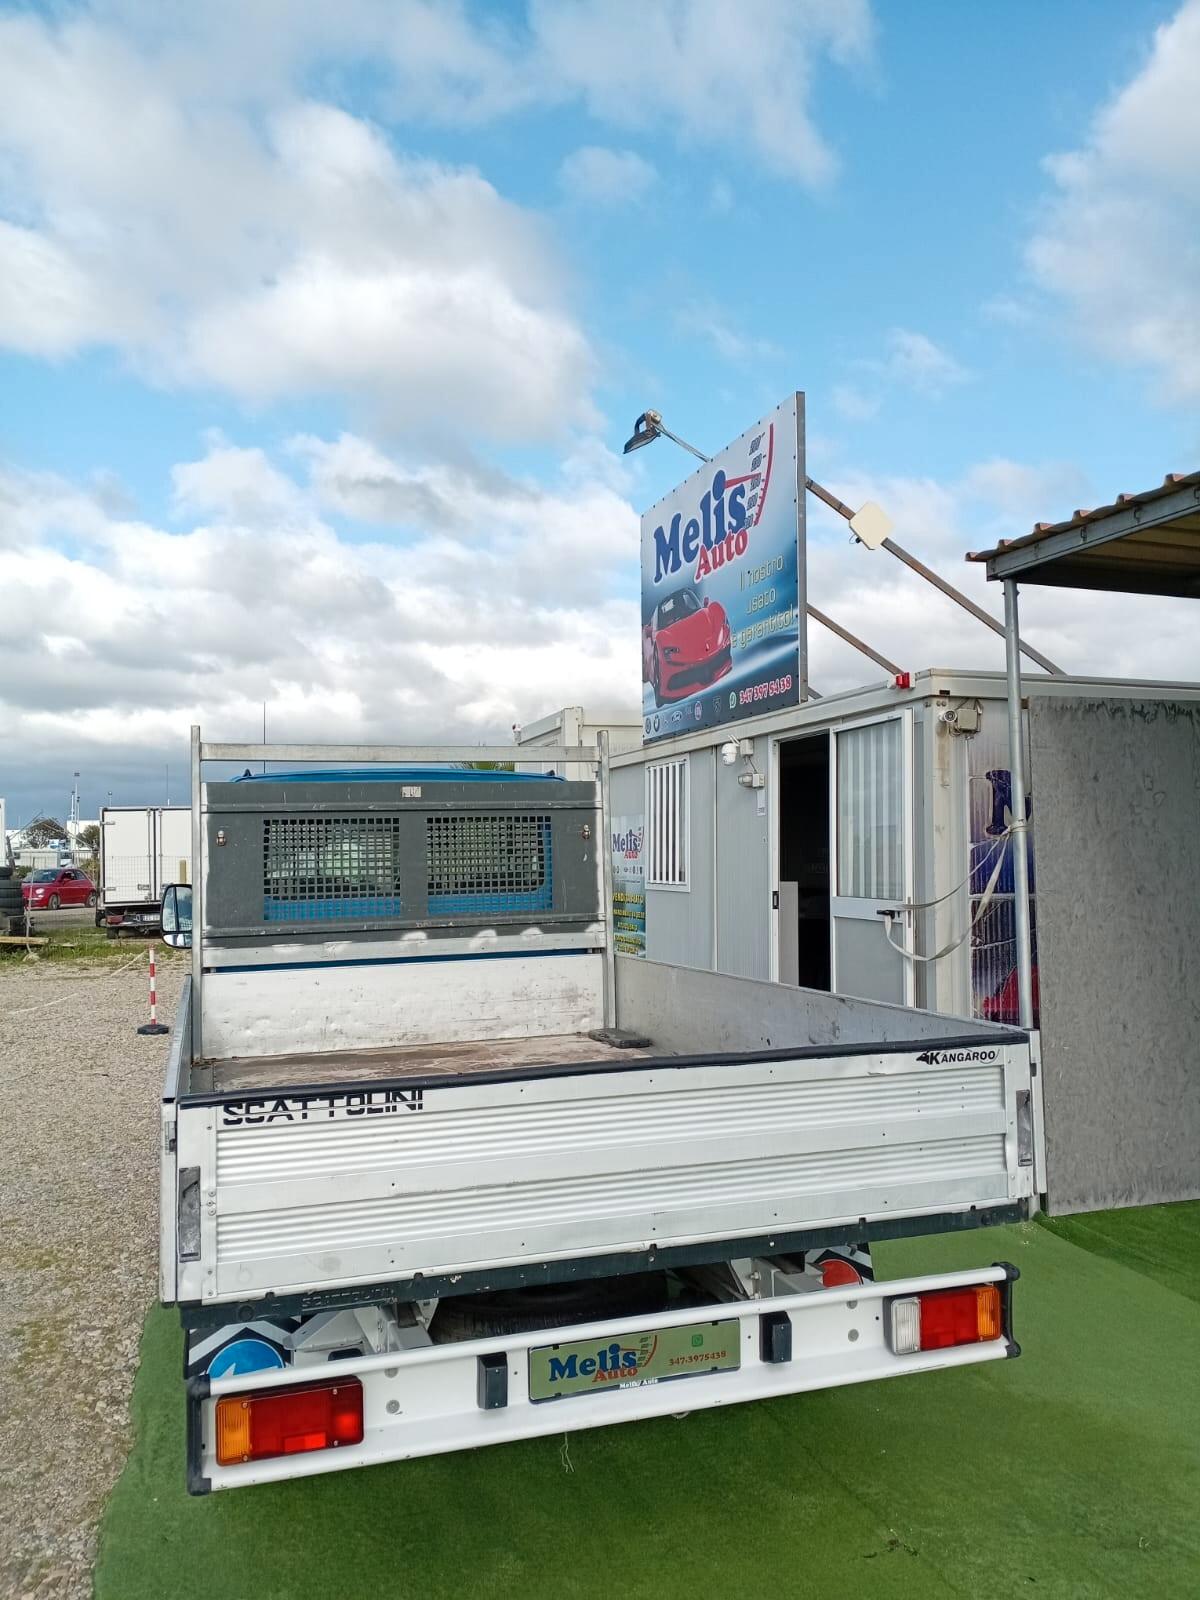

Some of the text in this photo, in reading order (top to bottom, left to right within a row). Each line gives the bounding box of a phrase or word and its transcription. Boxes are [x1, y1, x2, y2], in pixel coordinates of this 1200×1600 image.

[653, 469, 747, 584] Melis
[694, 528, 749, 582] Auto
[748, 554, 785, 588] nostro
[612, 829, 639, 853] Melis
[929, 1049, 997, 1066] KANGAROO
[222, 1088, 424, 1126] SCATTOLINI
[548, 1343, 638, 1383] Melis
[591, 1367, 639, 1384] Auto
